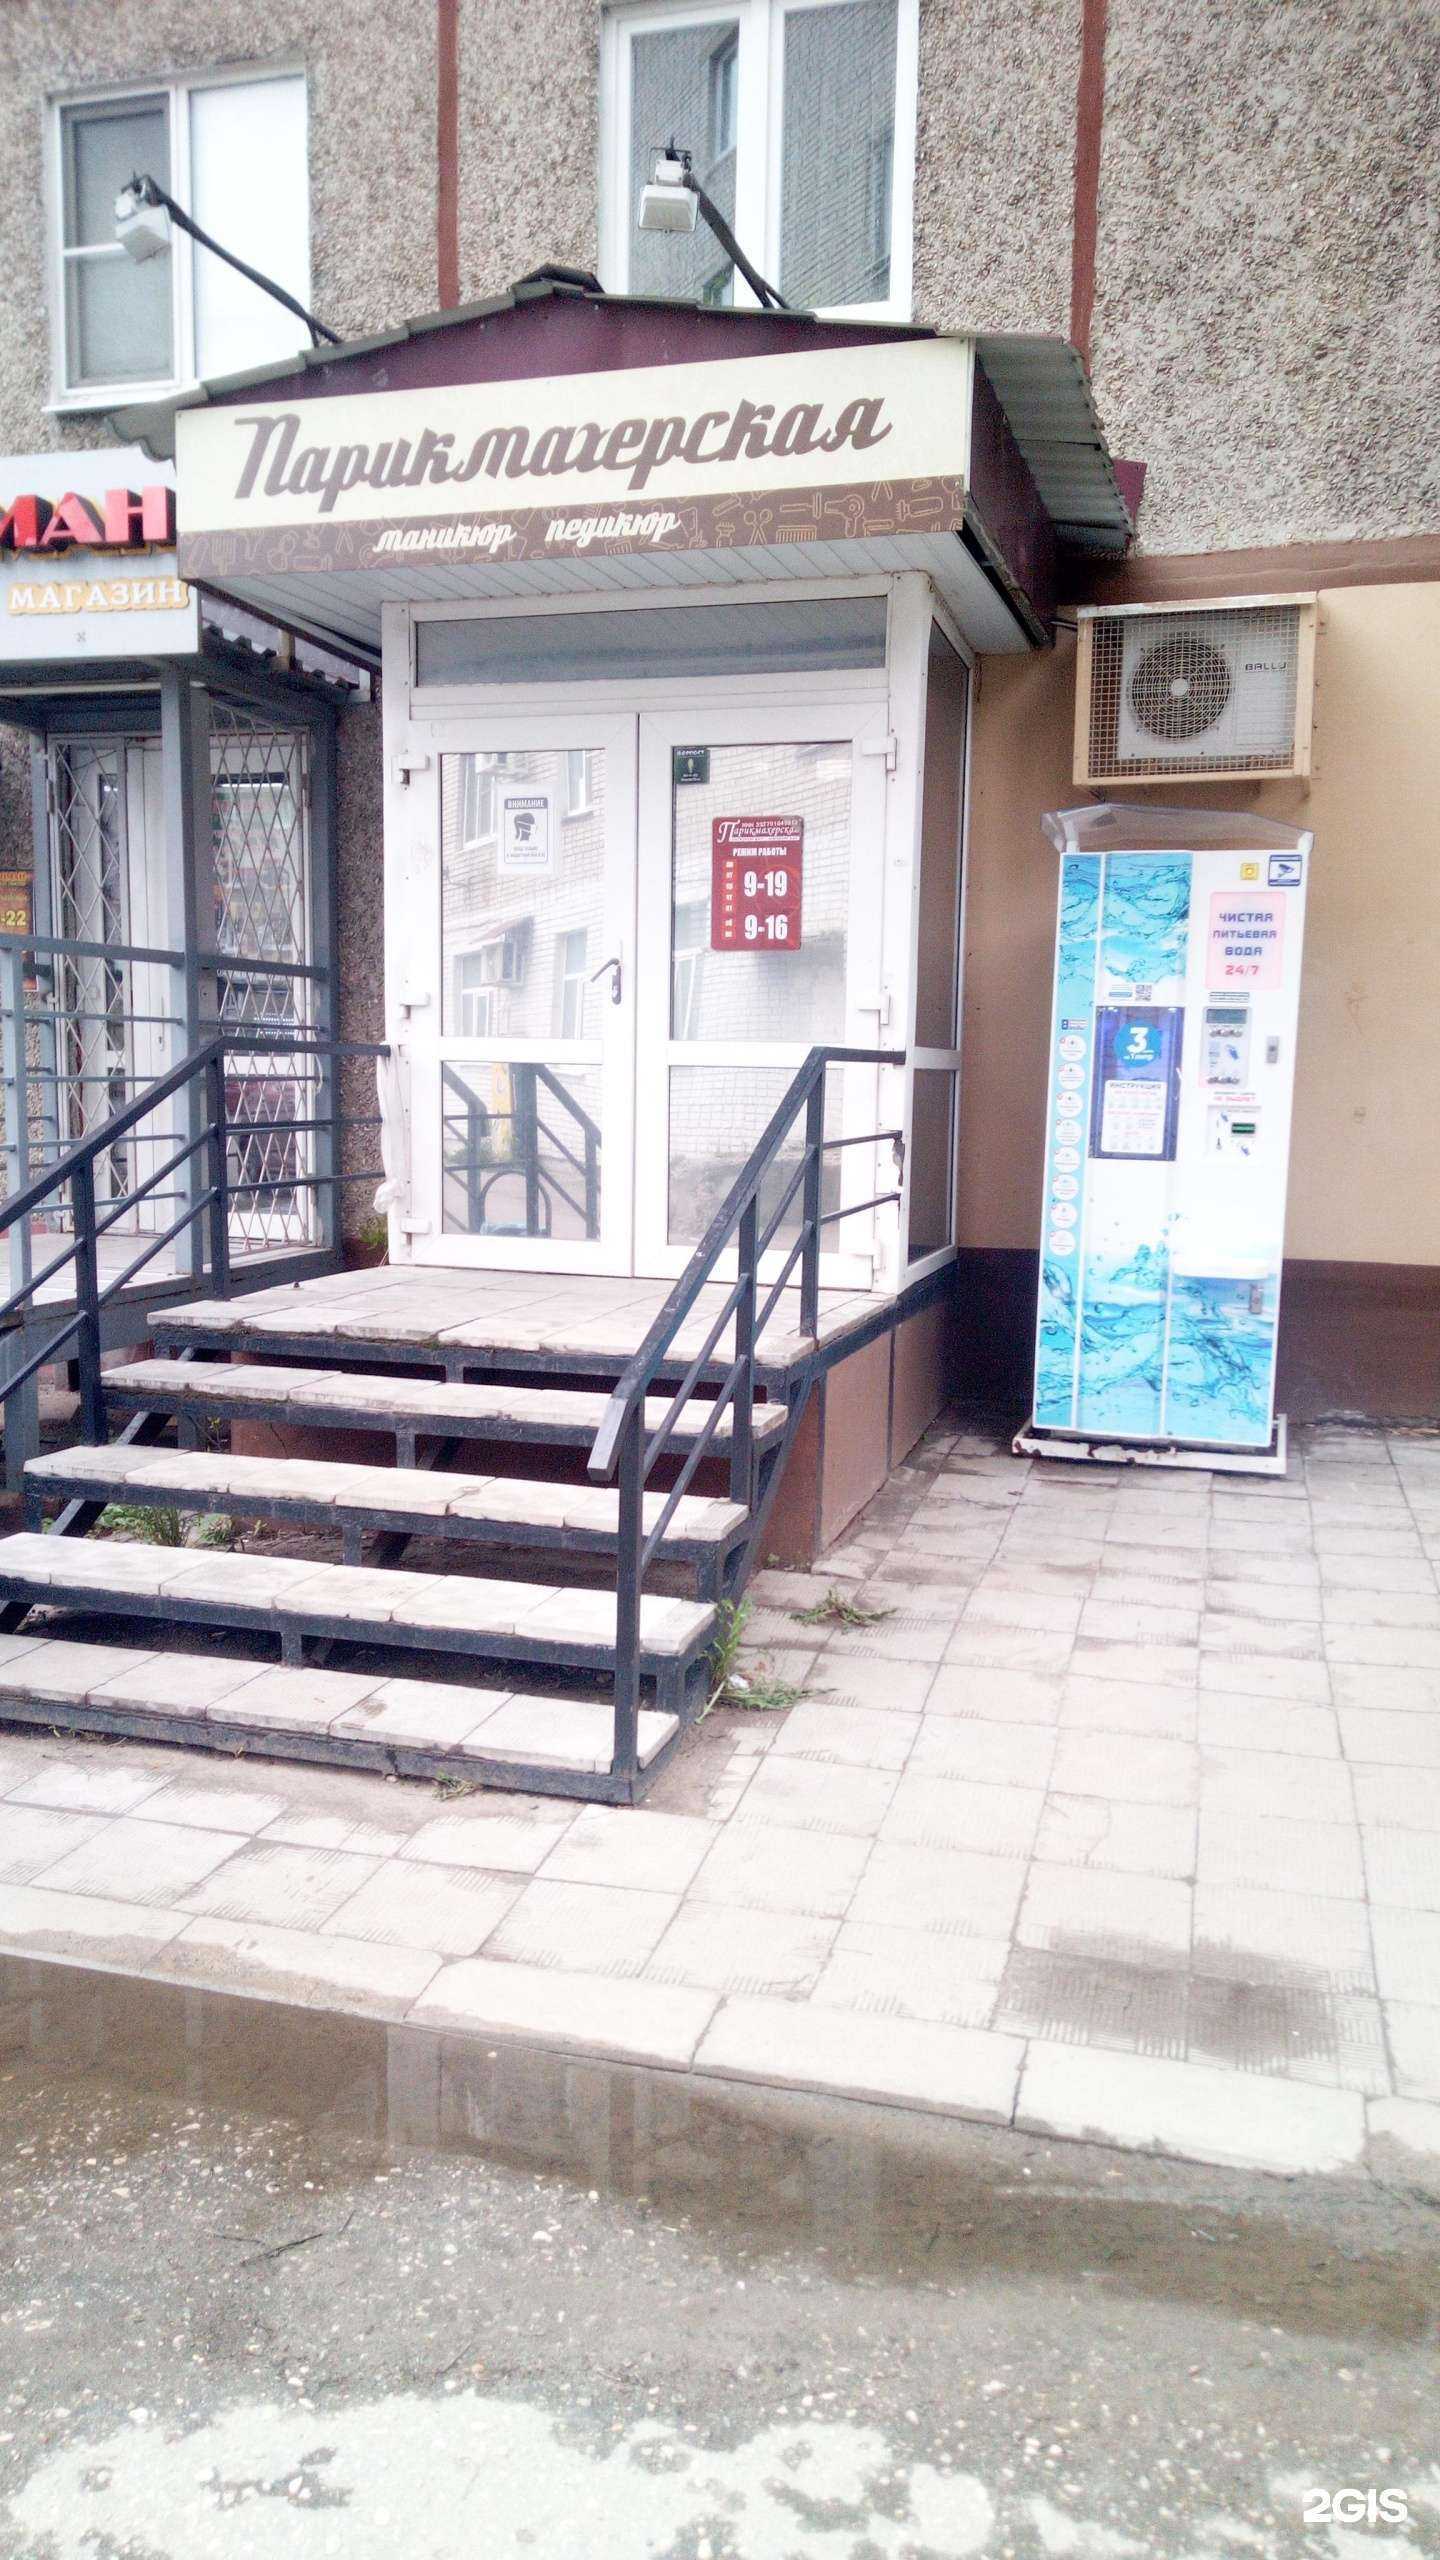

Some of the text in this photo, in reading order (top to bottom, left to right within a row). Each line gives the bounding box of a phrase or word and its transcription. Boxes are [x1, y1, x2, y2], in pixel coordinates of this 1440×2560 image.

[234, 397, 893, 513] Парикмахерская
[372, 511, 681, 553] маникюр педикюр
[10, 579, 183, 609] МАГАЗИН
[758, 847, 787, 856] РАБОТЫ
[744, 871, 787, 897] 9-19
[1218, 912, 1273, 922] ЧИСТАЯ
[744, 914, 788, 940] 9-16
[1212, 929, 1277, 939] ПИТЬЕВАЯ
[1225, 946, 1262, 956] ВОДА
[1225, 964, 1259, 975] 24/7
